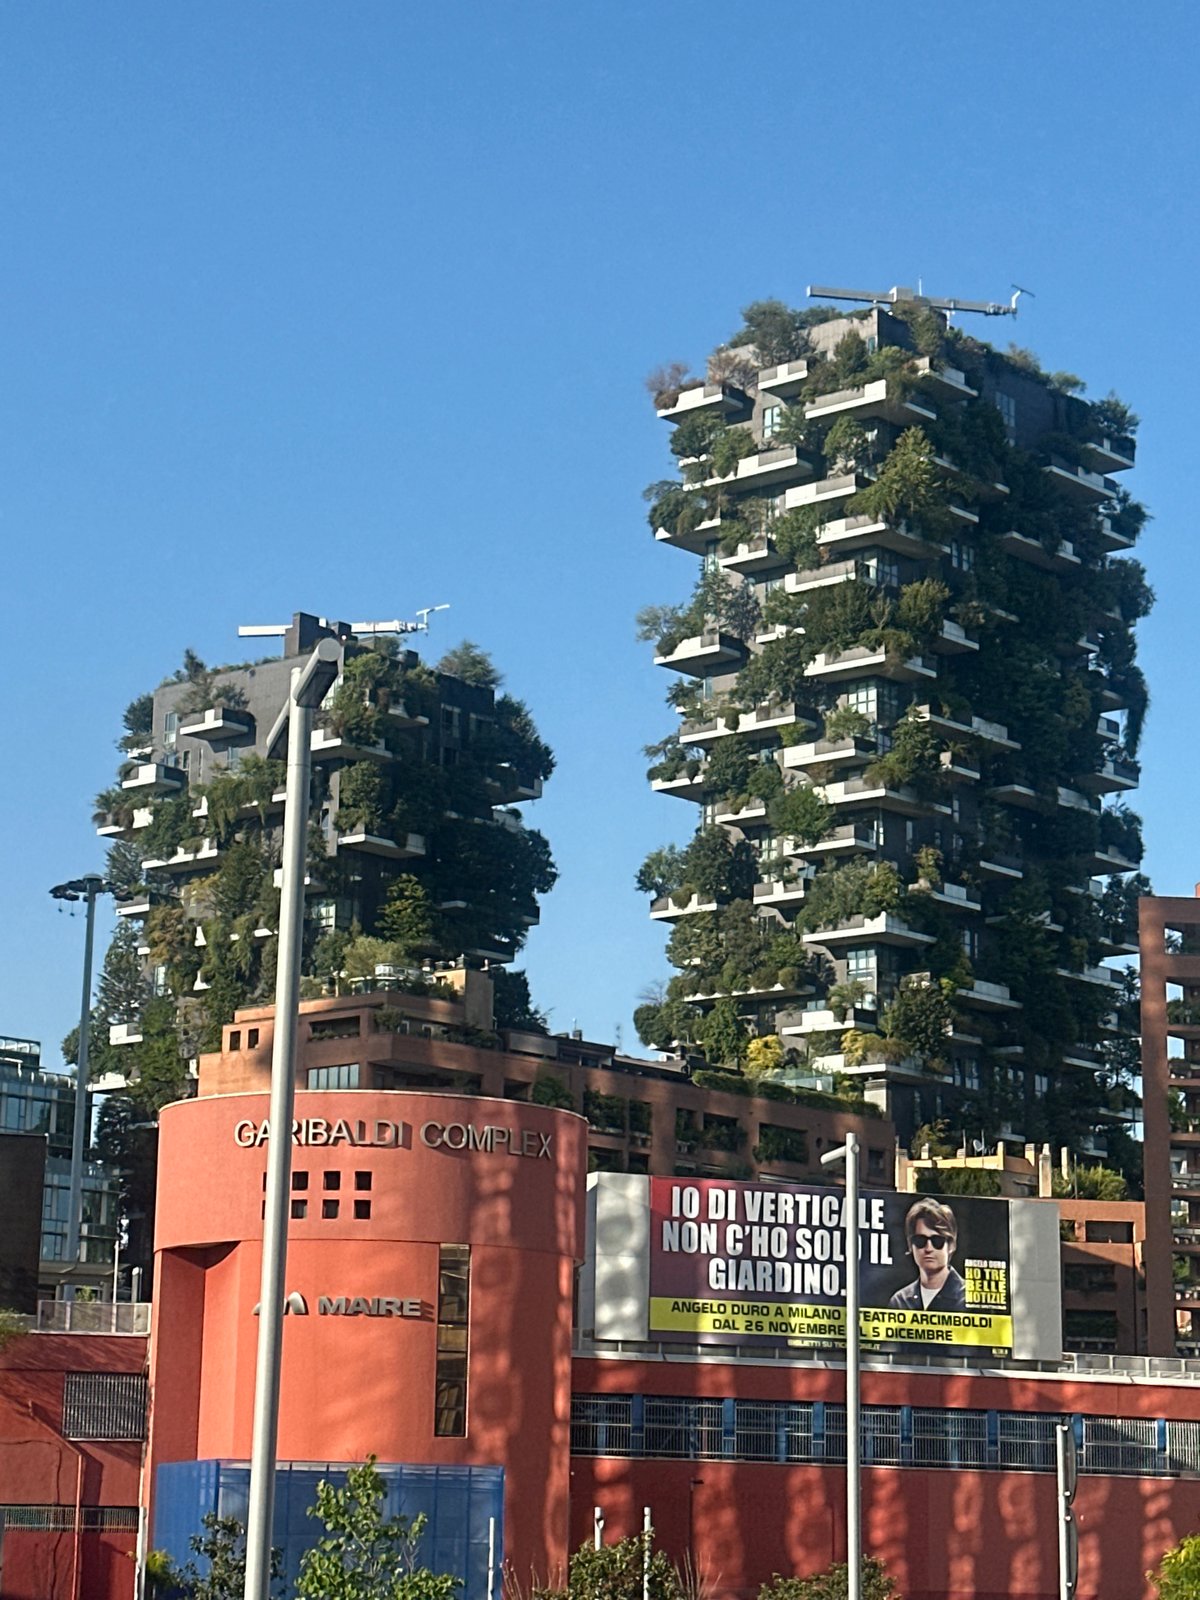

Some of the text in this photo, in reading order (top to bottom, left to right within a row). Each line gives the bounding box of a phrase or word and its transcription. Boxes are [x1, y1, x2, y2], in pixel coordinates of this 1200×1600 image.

[420, 1121, 552, 1159] COMPLEX
[671, 1186, 700, 1219] IO
[708, 1188, 736, 1221] DI
[662, 1220, 893, 1265] NON C'HO SOL IL
[708, 1257, 847, 1297] GIARDINO.
[965, 1268, 1006, 1281] HO TRE
[965, 1279, 1007, 1292] BELLE
[318, 1296, 421, 1317] MAIRE
[965, 1291, 1007, 1304] NOTIZIE
[671, 1301, 726, 1315] ANGELO
[731, 1304, 770, 1316] DURO
[774, 1307, 784, 1317] A
[788, 1306, 841, 1320] MILANO
[910, 1313, 992, 1328] ARCIMBOLDI
[712, 1318, 740, 1331] DAL
[744, 1320, 764, 1331] 26
[768, 1321, 846, 1336] NOVEMBRE
[872, 1327, 880, 1338] 5
[885, 1327, 953, 1341] DICEMBRE
